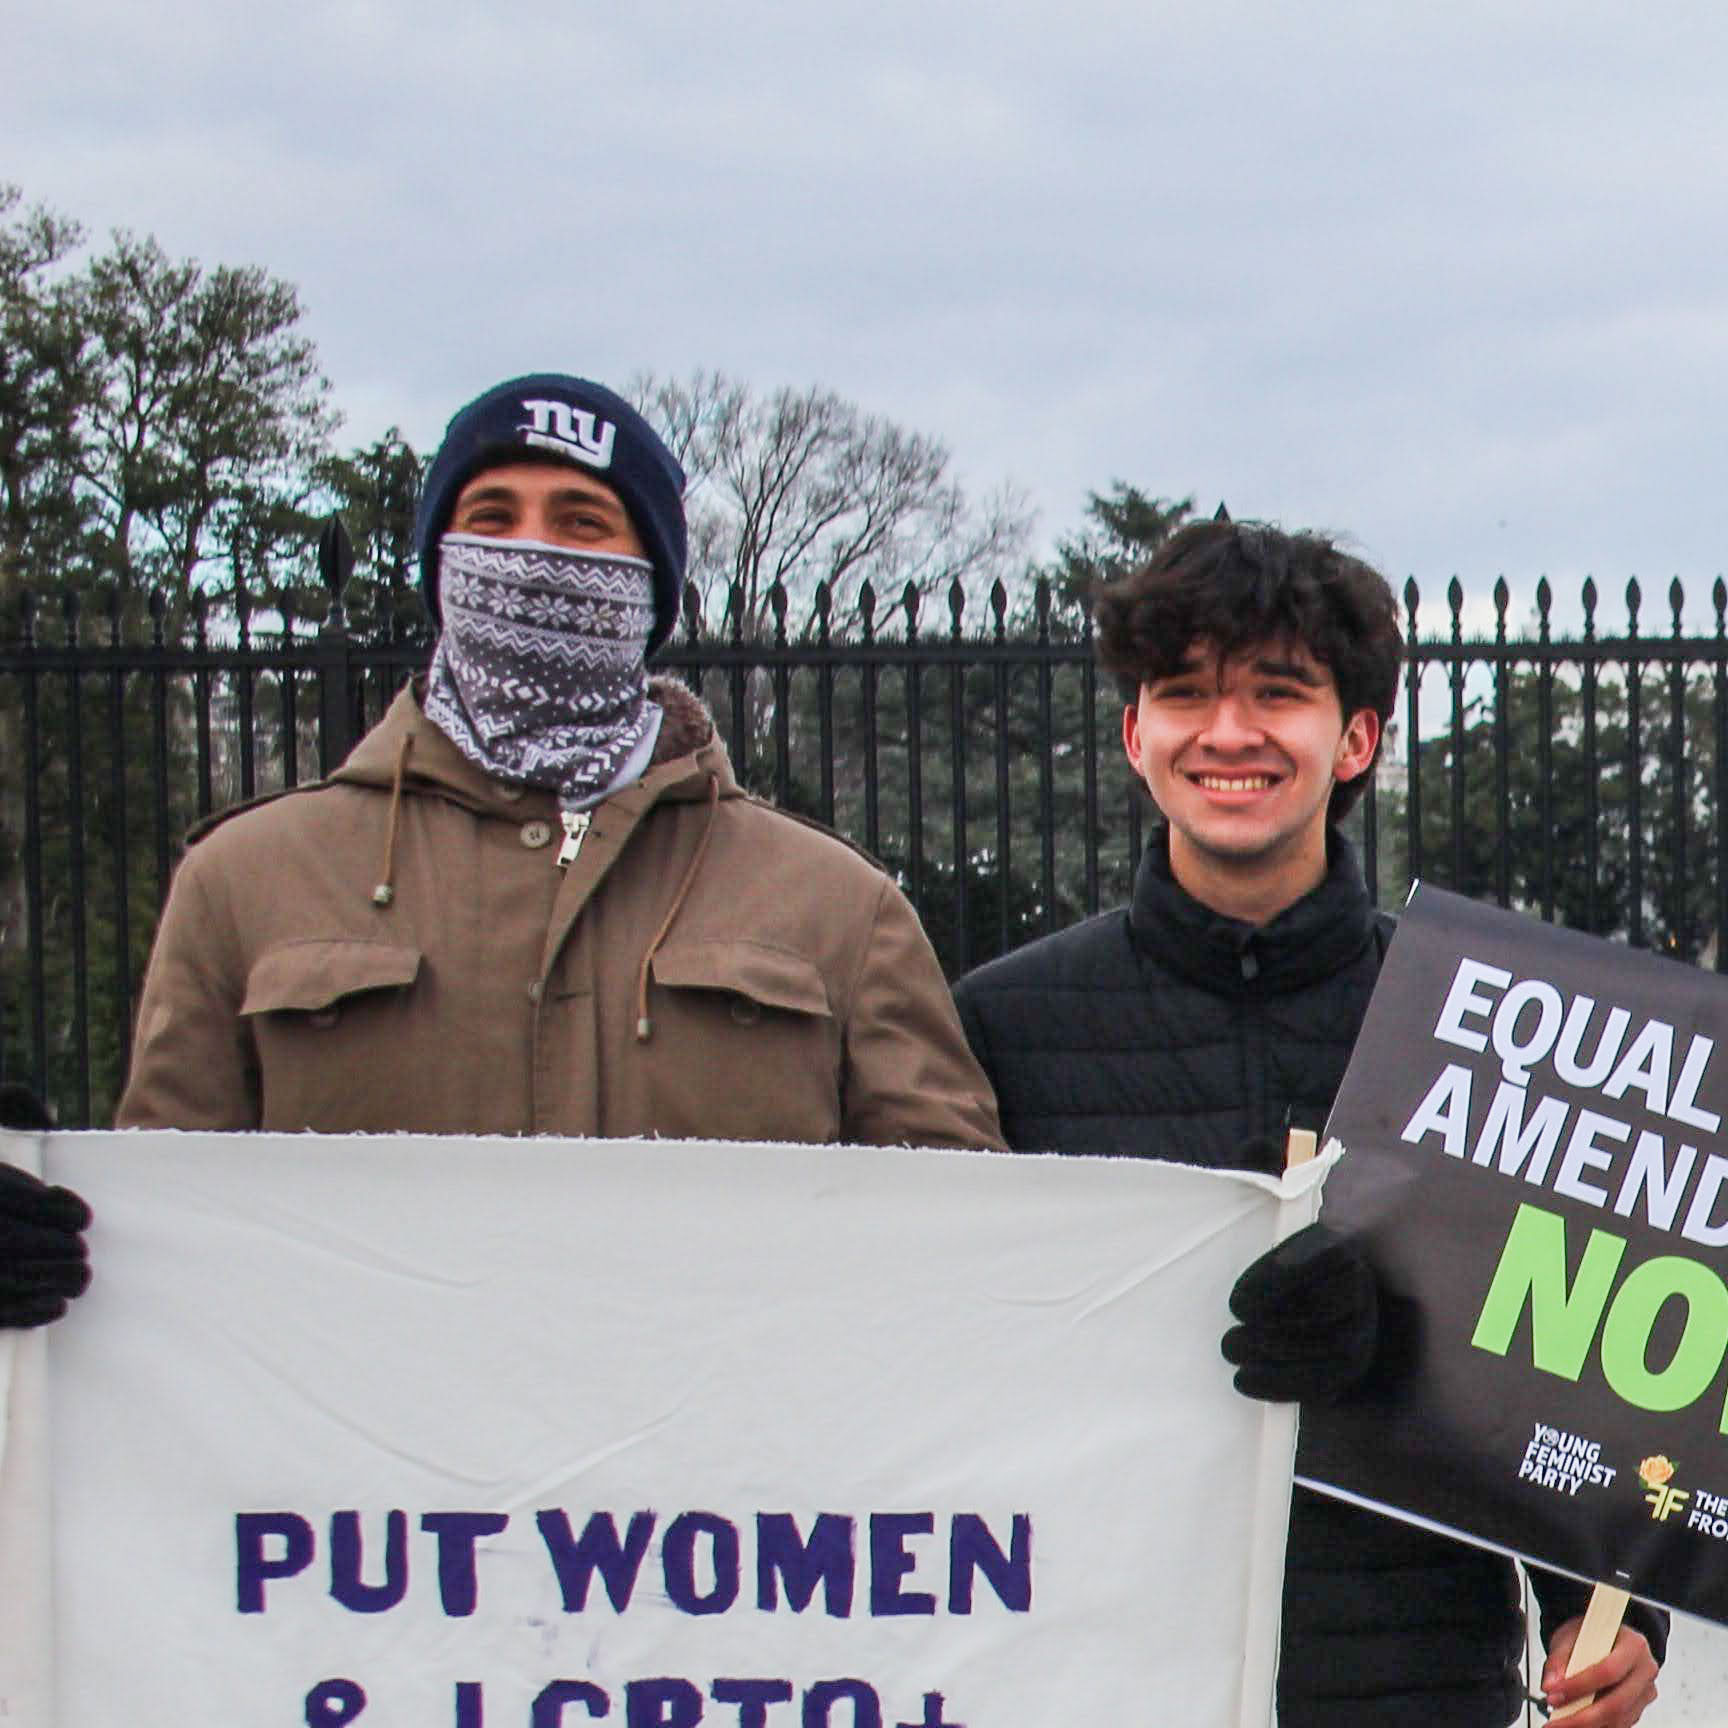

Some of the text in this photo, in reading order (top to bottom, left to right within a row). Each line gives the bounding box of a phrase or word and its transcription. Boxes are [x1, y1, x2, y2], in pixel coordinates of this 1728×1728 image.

[1433, 957, 1722, 1134] EQUAL
[1524, 1441, 1616, 1488] FEMINIST
[1533, 1422, 1601, 1461] YOUNG
[1518, 1459, 1584, 1496] PARTY
[234, 1507, 1034, 1618] PUT WOMEN
